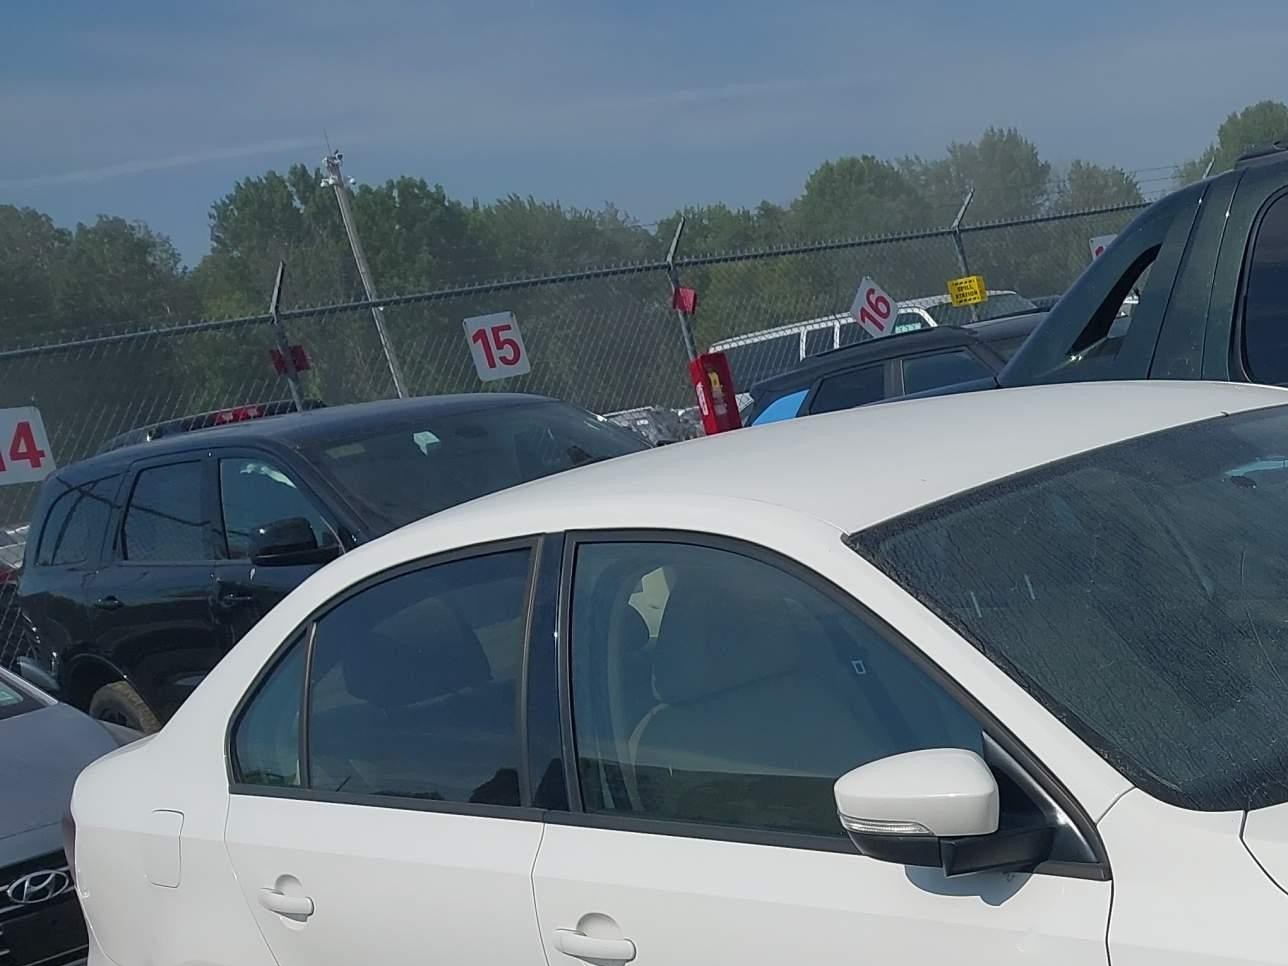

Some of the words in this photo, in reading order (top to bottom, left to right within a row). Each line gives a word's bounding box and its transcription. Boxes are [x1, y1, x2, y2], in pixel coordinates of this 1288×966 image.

[860, 288, 891, 332] 16
[955, 290, 978, 299] STATION
[472, 324, 521, 369] 15
[0, 421, 46, 472] 4
